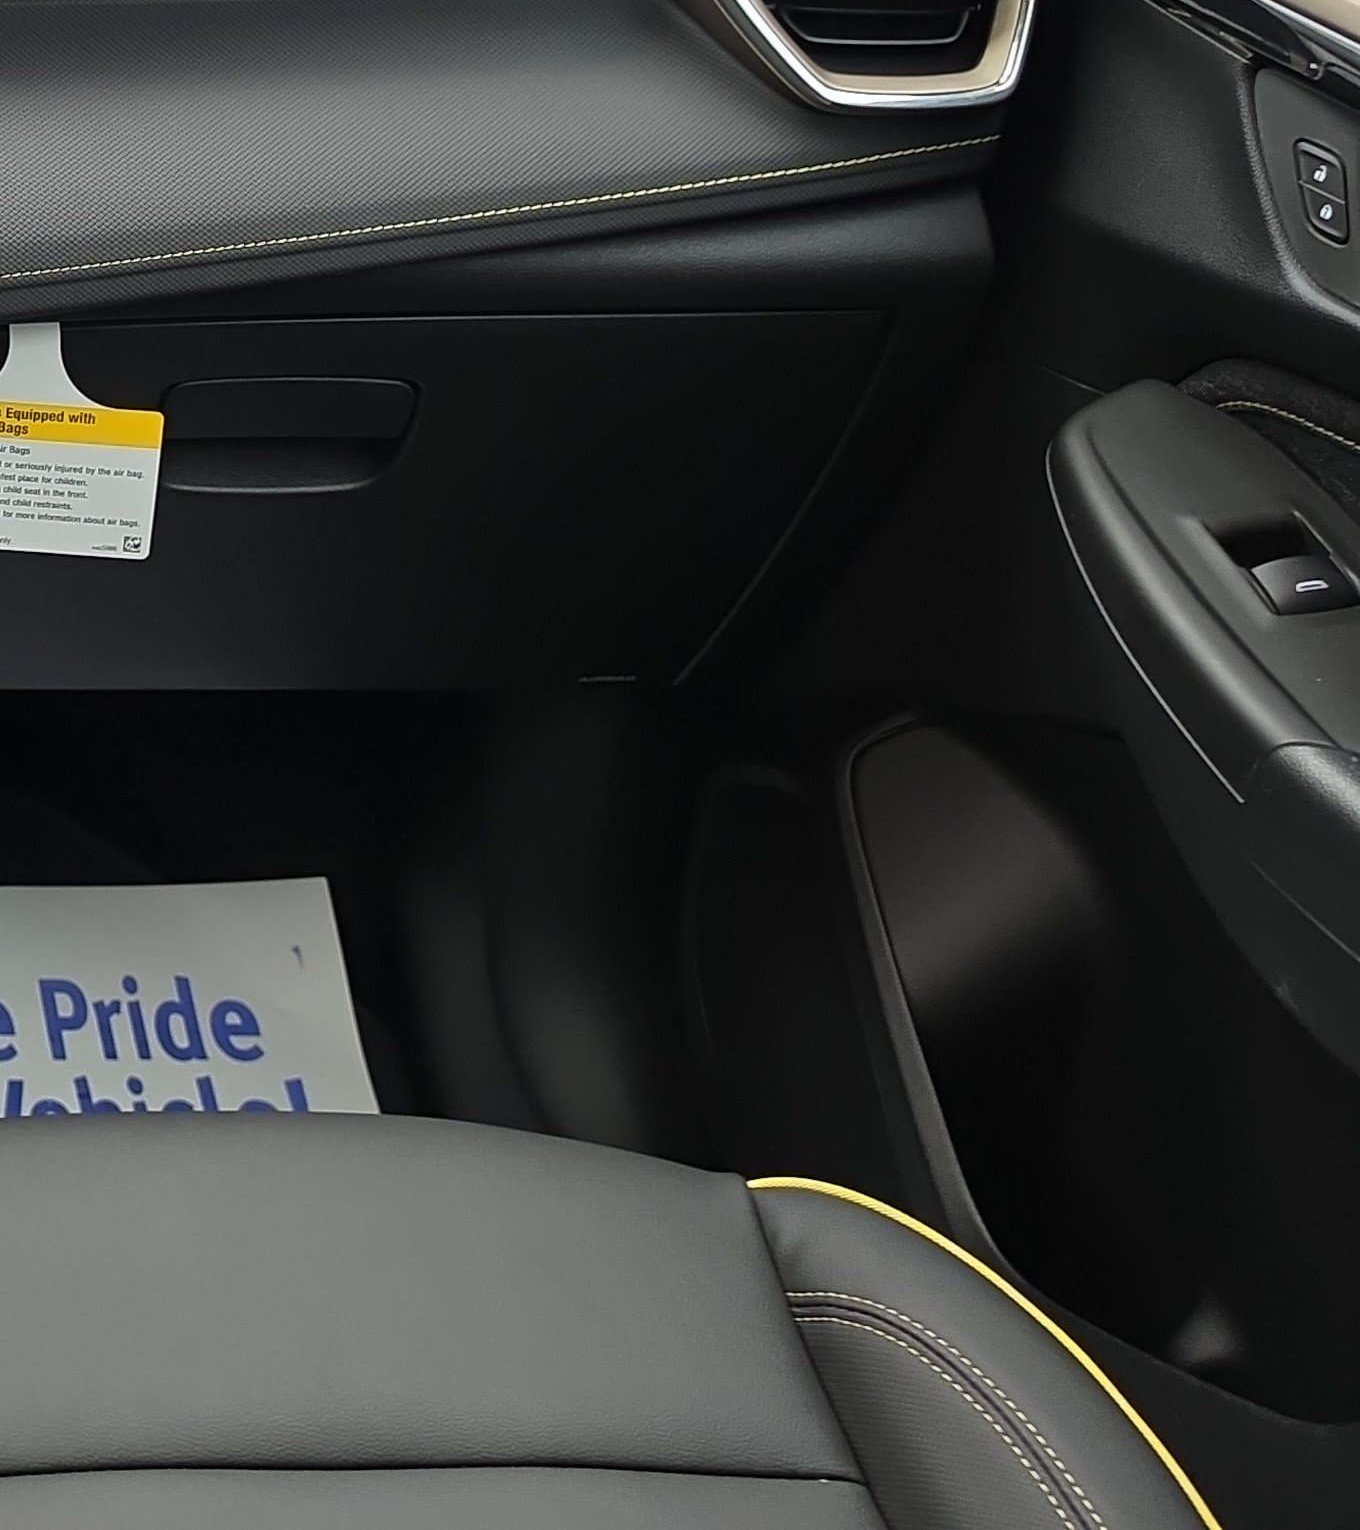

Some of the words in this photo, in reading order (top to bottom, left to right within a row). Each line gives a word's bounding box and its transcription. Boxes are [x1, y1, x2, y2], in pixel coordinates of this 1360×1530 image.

[5, 407, 64, 423] Equipped
[68, 411, 96, 424] with
[9, 445, 30, 456] Bags
[15, 461, 52, 473] seriously
[54, 464, 83, 474] injured
[85, 466, 95, 476] by
[98, 467, 111, 476] the
[113, 469, 124, 477] air
[18, 473, 39, 484] place
[42, 475, 52, 483] for
[3, 485, 22, 495] child
[25, 488, 40, 496] seat
[52, 490, 65, 498] the
[12, 499, 31, 507] child
[38, 974, 265, 1062] Pride
